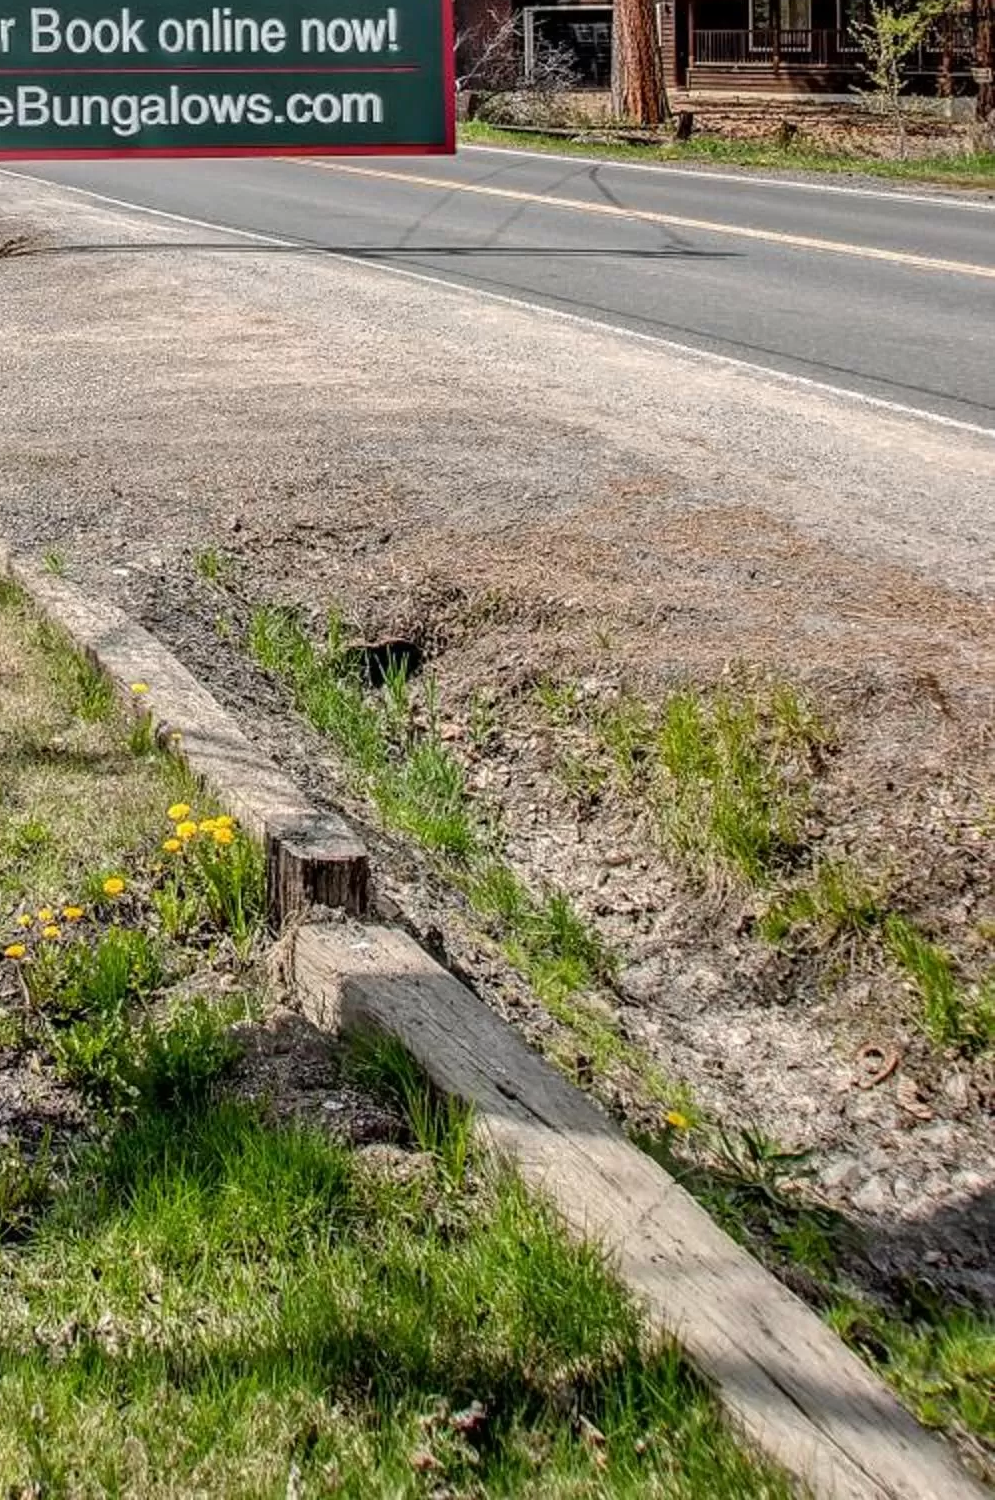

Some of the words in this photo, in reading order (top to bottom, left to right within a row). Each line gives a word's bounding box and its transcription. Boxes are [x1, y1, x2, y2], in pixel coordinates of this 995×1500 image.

[30, 7, 146, 53] Book
[158, 7, 287, 53] online
[301, 7, 399, 53] now!
